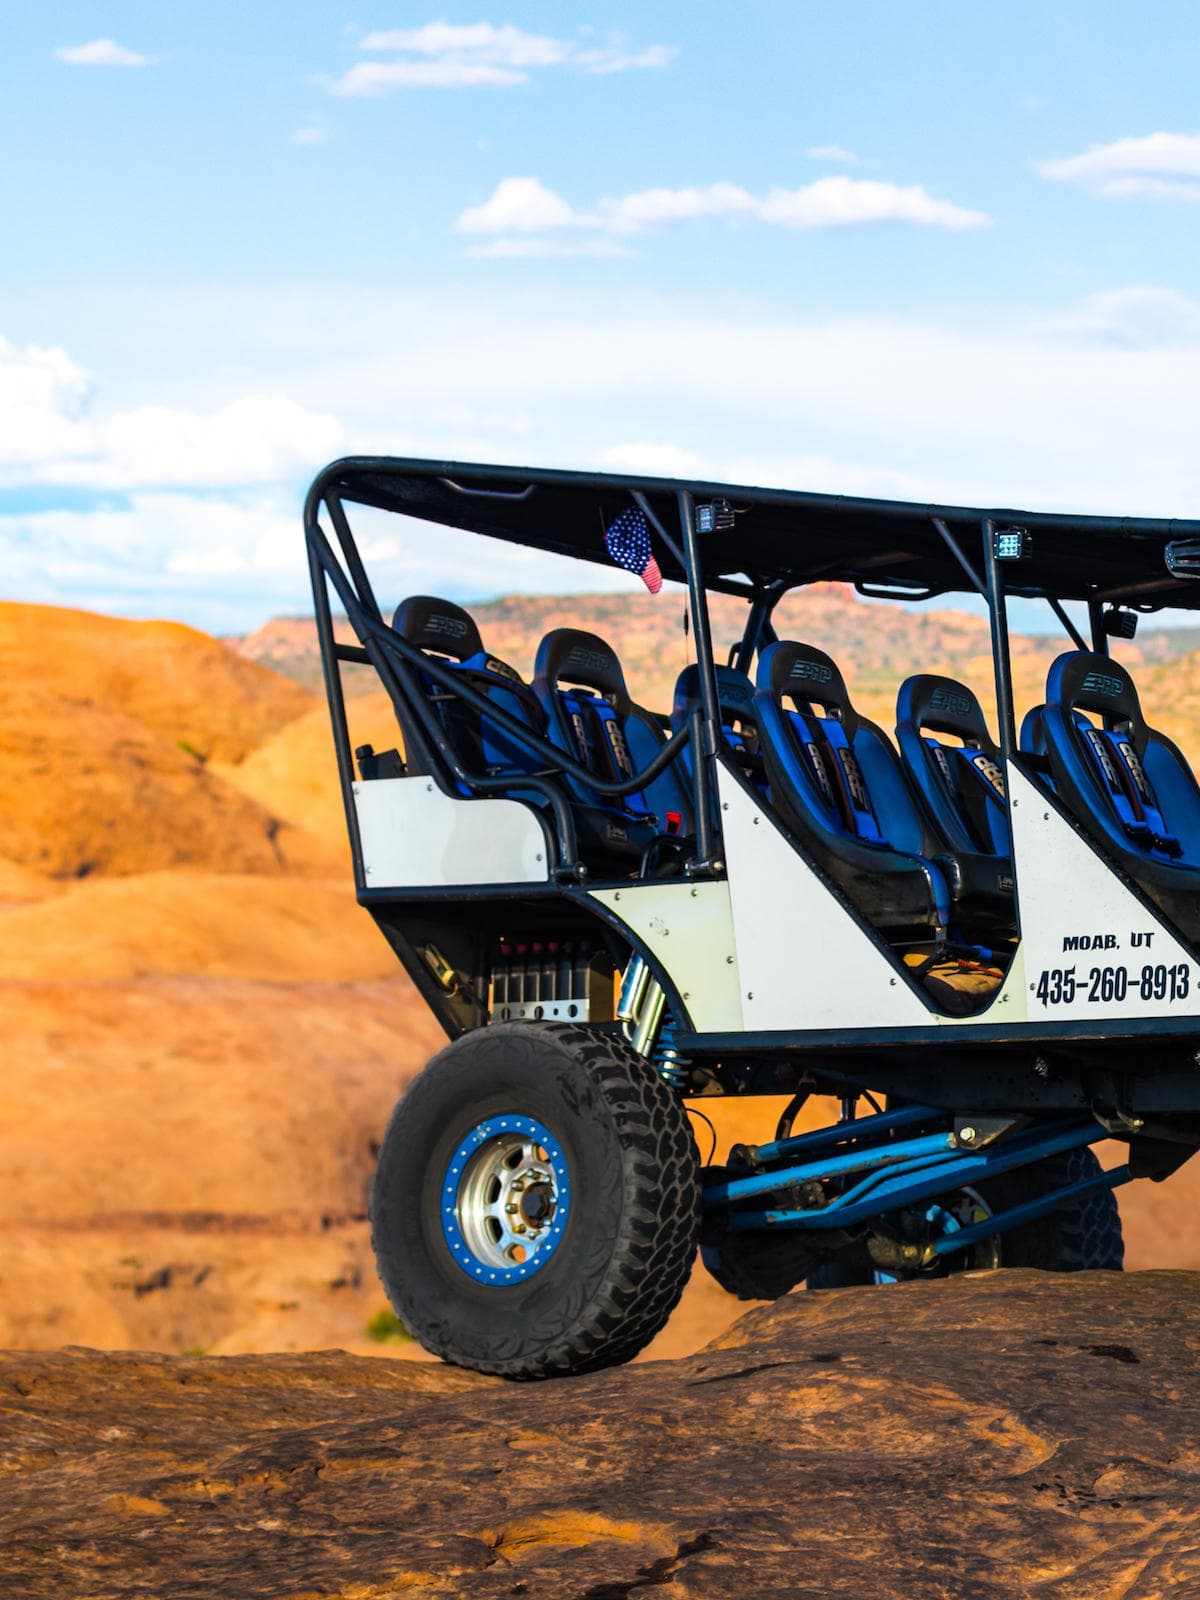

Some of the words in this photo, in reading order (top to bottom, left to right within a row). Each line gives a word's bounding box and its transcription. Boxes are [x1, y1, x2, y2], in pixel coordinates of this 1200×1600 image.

[1063, 934, 1120, 953] MOAB,
[1130, 932, 1155, 949] UT
[1036, 963, 1190, 1009] 435-260-8913
